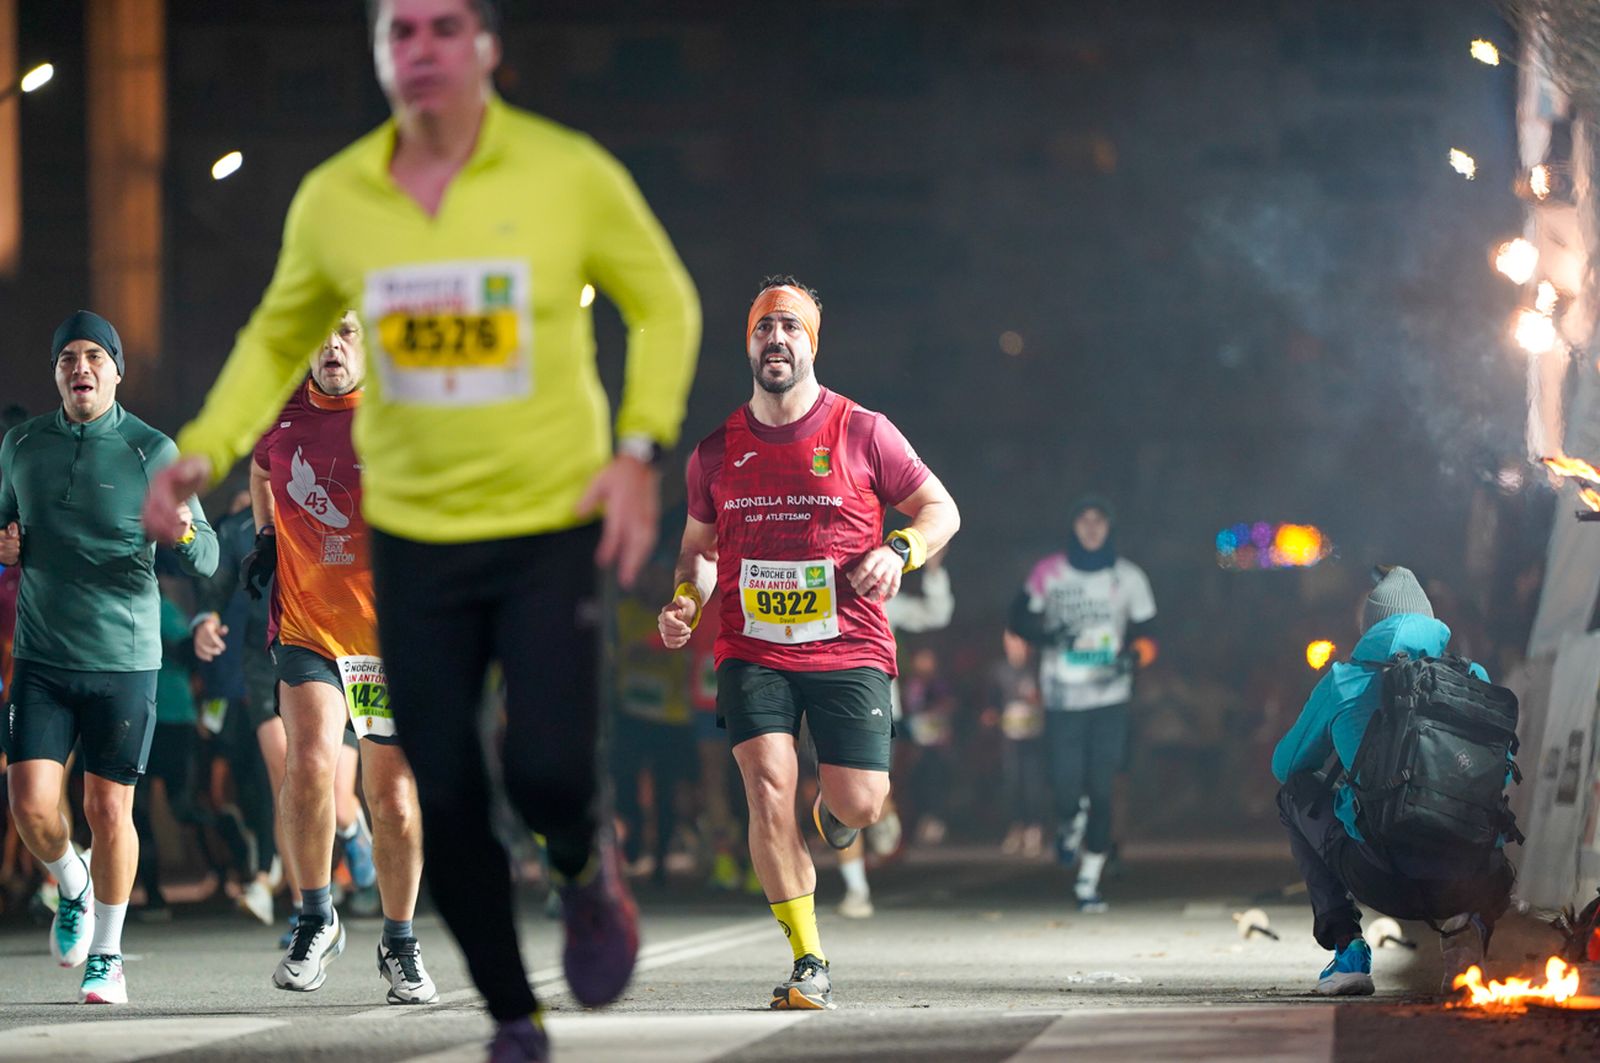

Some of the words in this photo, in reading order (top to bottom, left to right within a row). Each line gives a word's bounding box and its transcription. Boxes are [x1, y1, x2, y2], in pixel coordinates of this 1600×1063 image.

[304, 491, 328, 516] 43
[723, 496, 782, 511] ARJONILLA
[786, 495, 843, 507] RUNNING
[745, 515, 763, 523] CLUB
[766, 513, 812, 521] ATLETISMO
[760, 570, 785, 579] NOCHE
[786, 571, 797, 579] DE
[749, 579, 766, 588] SAN
[767, 580, 798, 589] ANTÓN
[756, 590, 818, 616] 9322
[351, 664, 377, 673] NOCHE
